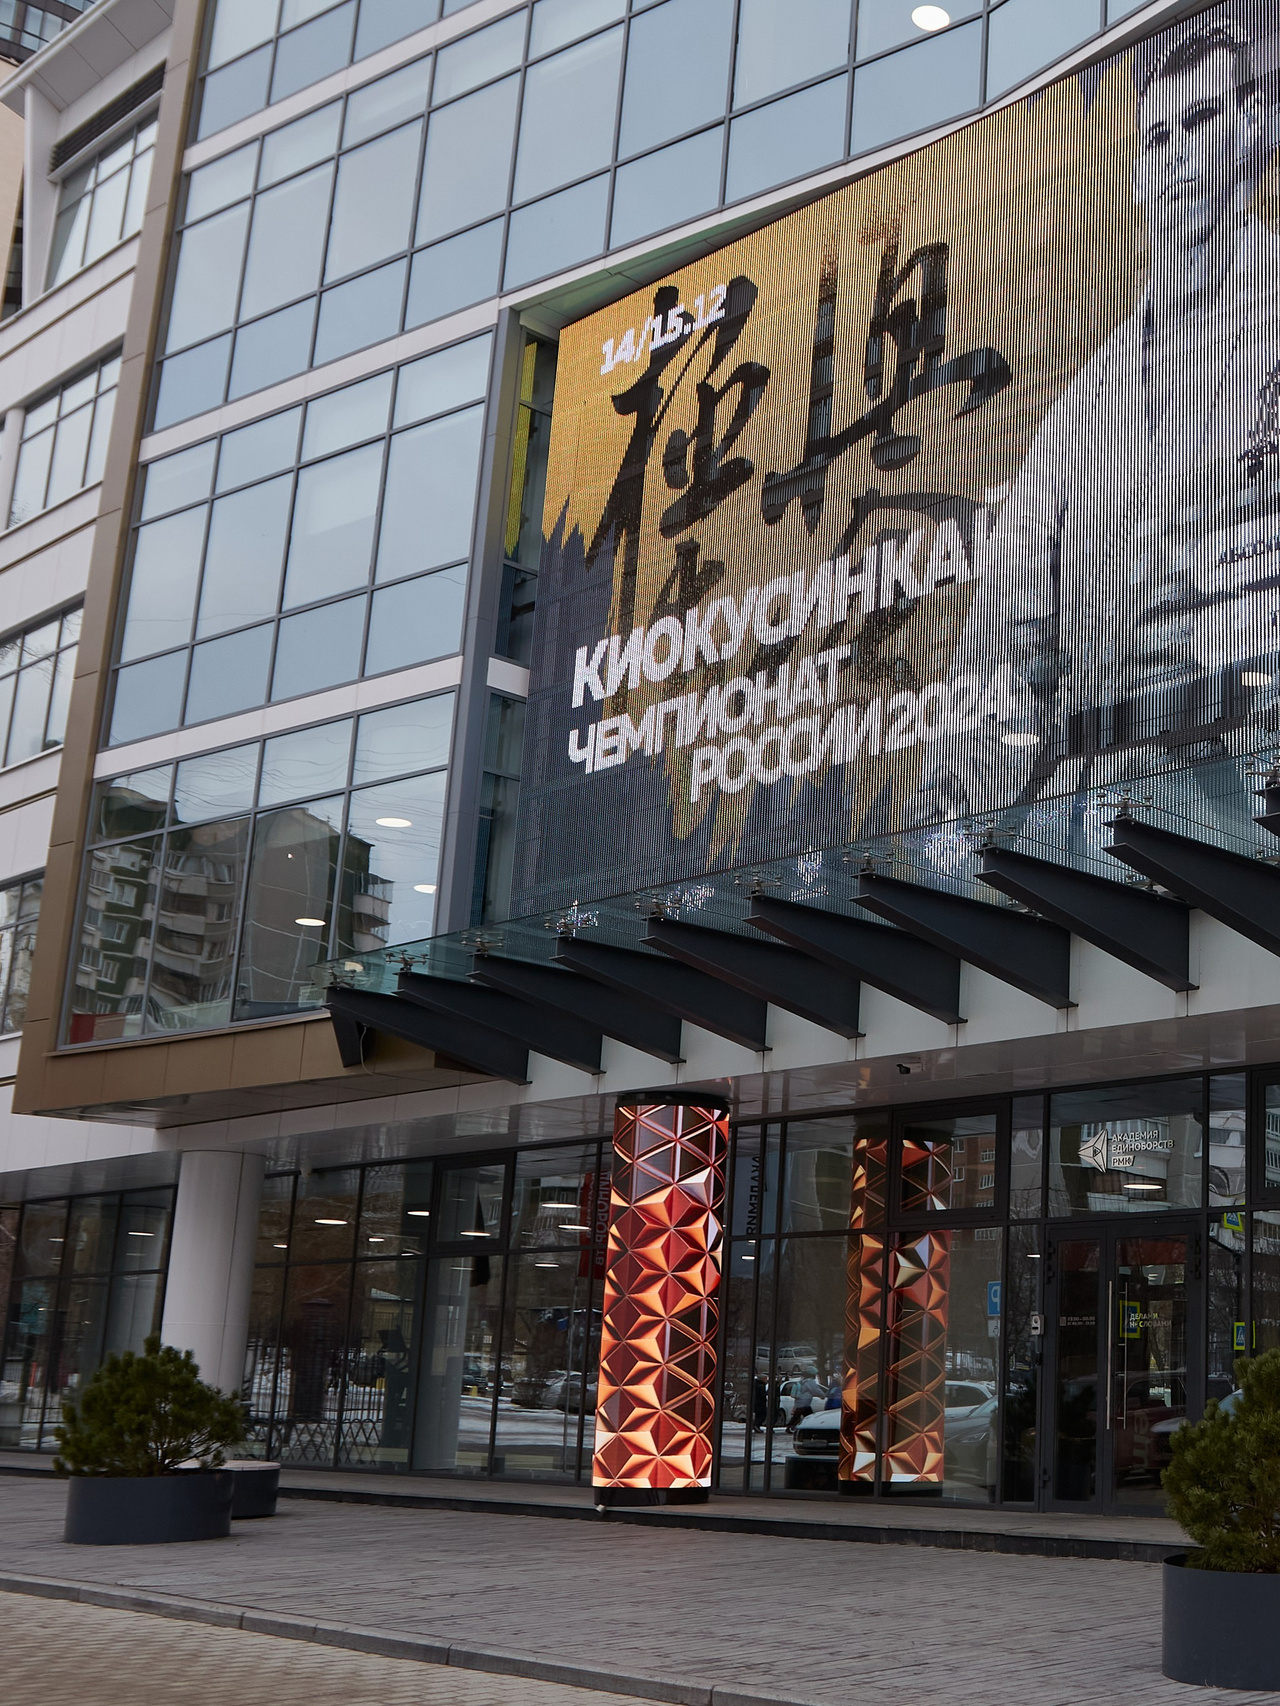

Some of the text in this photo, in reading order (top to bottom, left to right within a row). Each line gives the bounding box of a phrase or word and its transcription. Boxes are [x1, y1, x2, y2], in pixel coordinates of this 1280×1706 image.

[601, 284, 727, 375] 14/15.12
[568, 644, 853, 775] ЧЕМПИОНАТ
[690, 662, 1016, 804] РОССИИ 2024
[1111, 1129, 1159, 1143] АКАДЕМИЯ
[1111, 1140, 1174, 1155] ЕДИНОБОРСТВ
